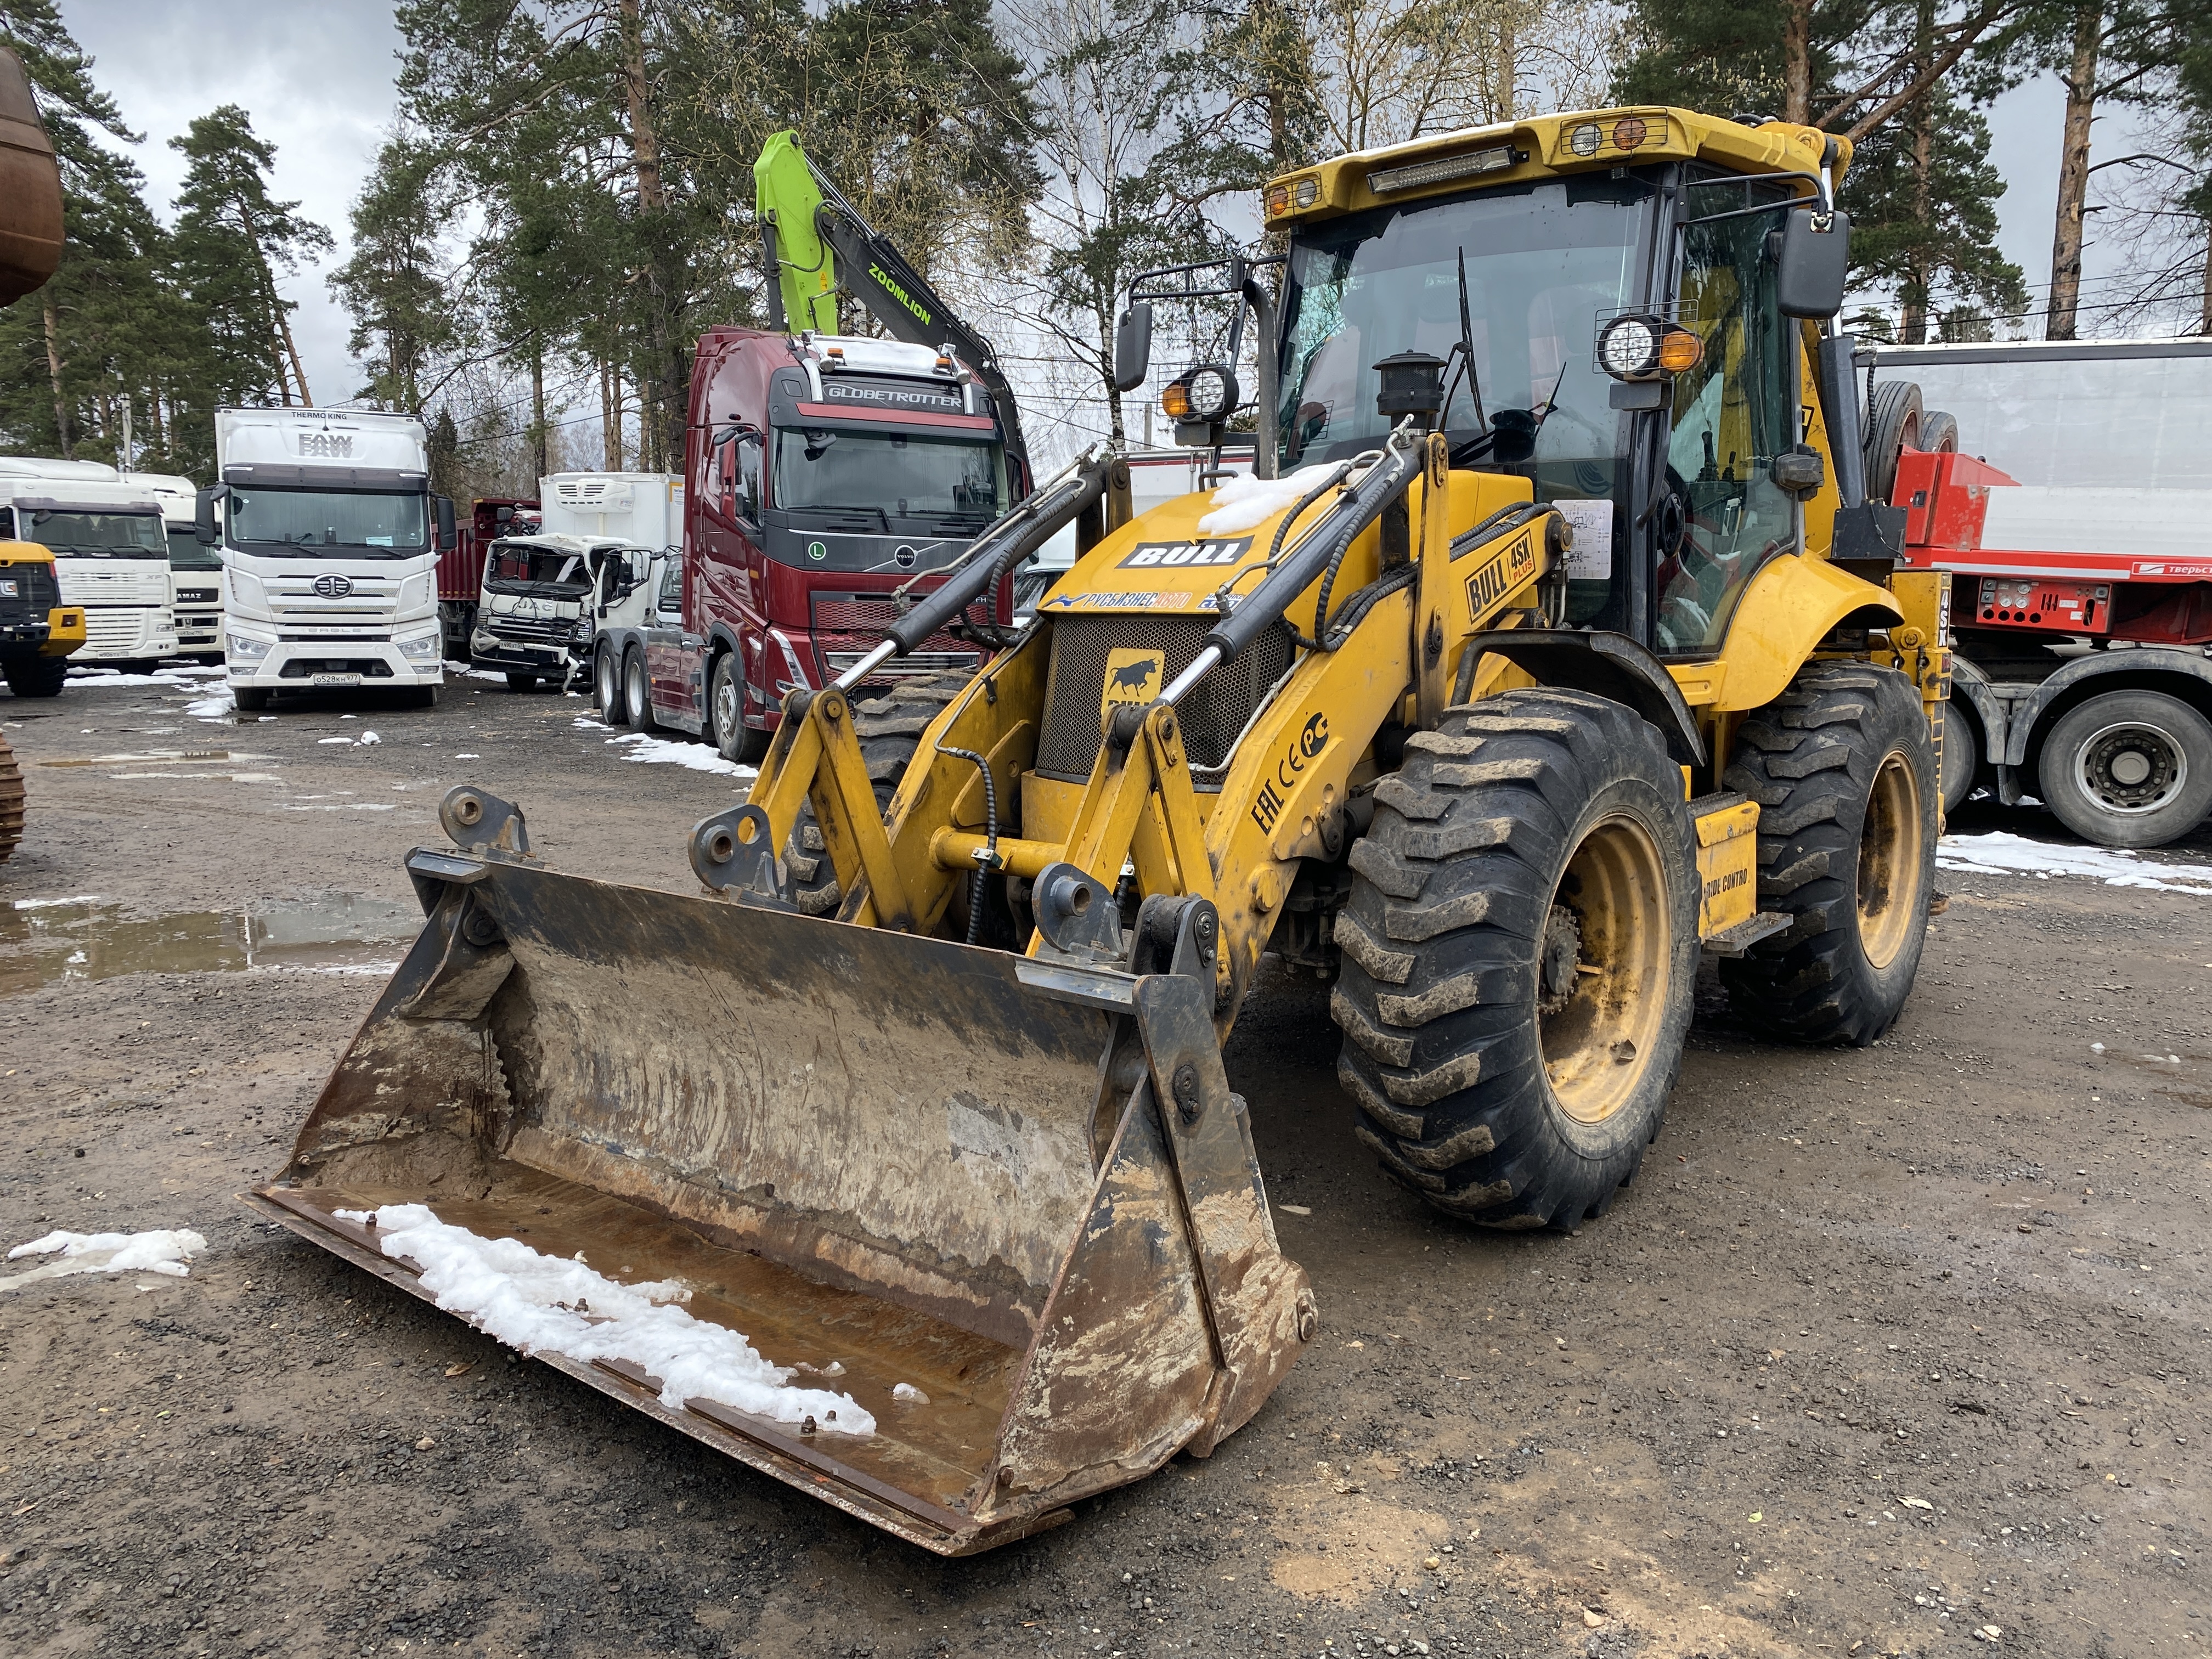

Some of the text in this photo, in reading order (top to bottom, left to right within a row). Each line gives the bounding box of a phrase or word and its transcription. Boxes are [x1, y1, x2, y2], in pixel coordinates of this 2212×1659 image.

[868, 262, 931, 326] ZOOMLION
[828, 387, 962, 408] GLOBETROTTER
[814, 545, 822, 557] L
[1127, 542, 1241, 566] BULL
[1511, 537, 1531, 570] 4SX
[1513, 560, 1532, 582] PLUS
[1469, 558, 1508, 615] BULL
[518, 601, 553, 611] JAC
[1939, 591, 1949, 647] 4SX
[1707, 868, 1750, 899] RIDE CONTRO
